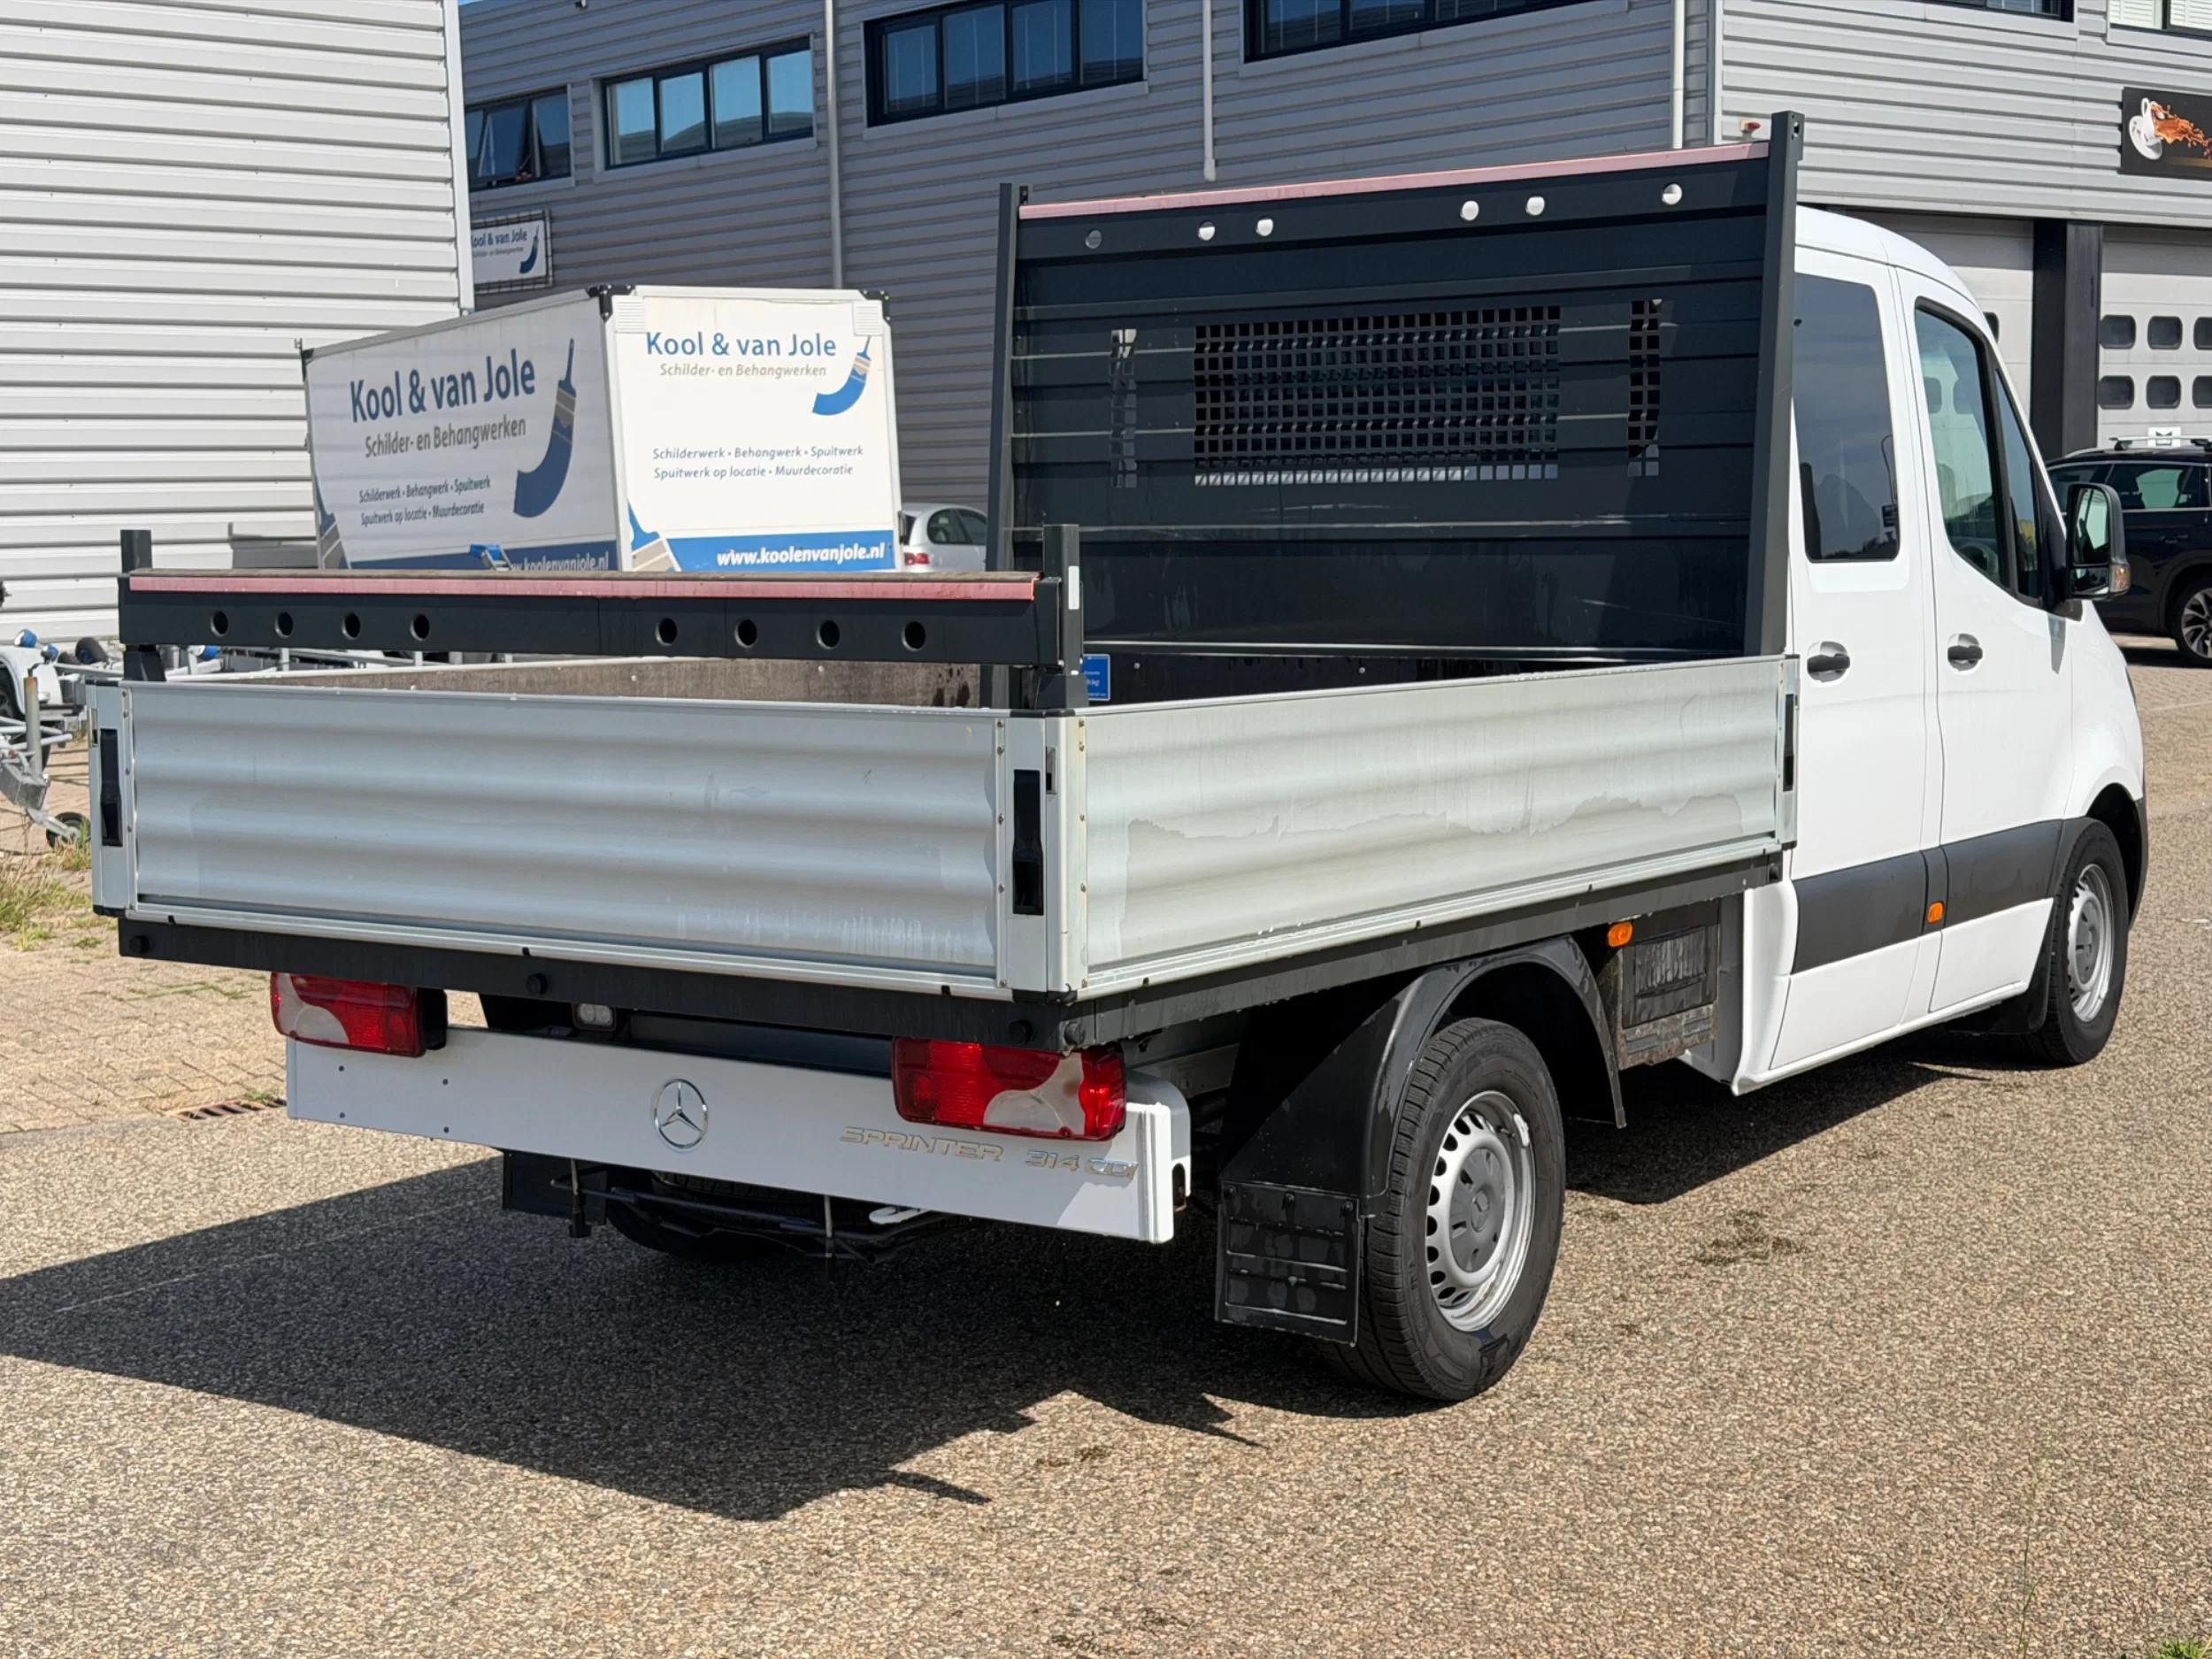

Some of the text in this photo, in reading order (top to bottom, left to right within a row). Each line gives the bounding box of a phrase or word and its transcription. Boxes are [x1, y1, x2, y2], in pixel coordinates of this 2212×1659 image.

[495, 233, 511, 245] van
[511, 227, 528, 243] Jole
[646, 331, 836, 356] Kool & van Jole
[659, 363, 826, 380] Schilder- en Behangwerken
[350, 348, 535, 423] Kool & van Jole
[365, 414, 526, 457] Schilder- en Behangwerken
[652, 445, 864, 460] Schilderwerk Behangwerk Spuitwerk
[654, 463, 853, 480] Spuitwerk op locatie Muurdecoratie
[358, 474, 491, 503] Schilderwerk Behangwerk Spuitwerk
[361, 510, 394, 527] Spuitwerk
[404, 505, 427, 521] locatie
[432, 500, 485, 518] Muurdecoratie
[717, 542, 885, 565] www.koolenvanjole.nl
[840, 1126, 1138, 1180] SPRINTER 314 CDI
